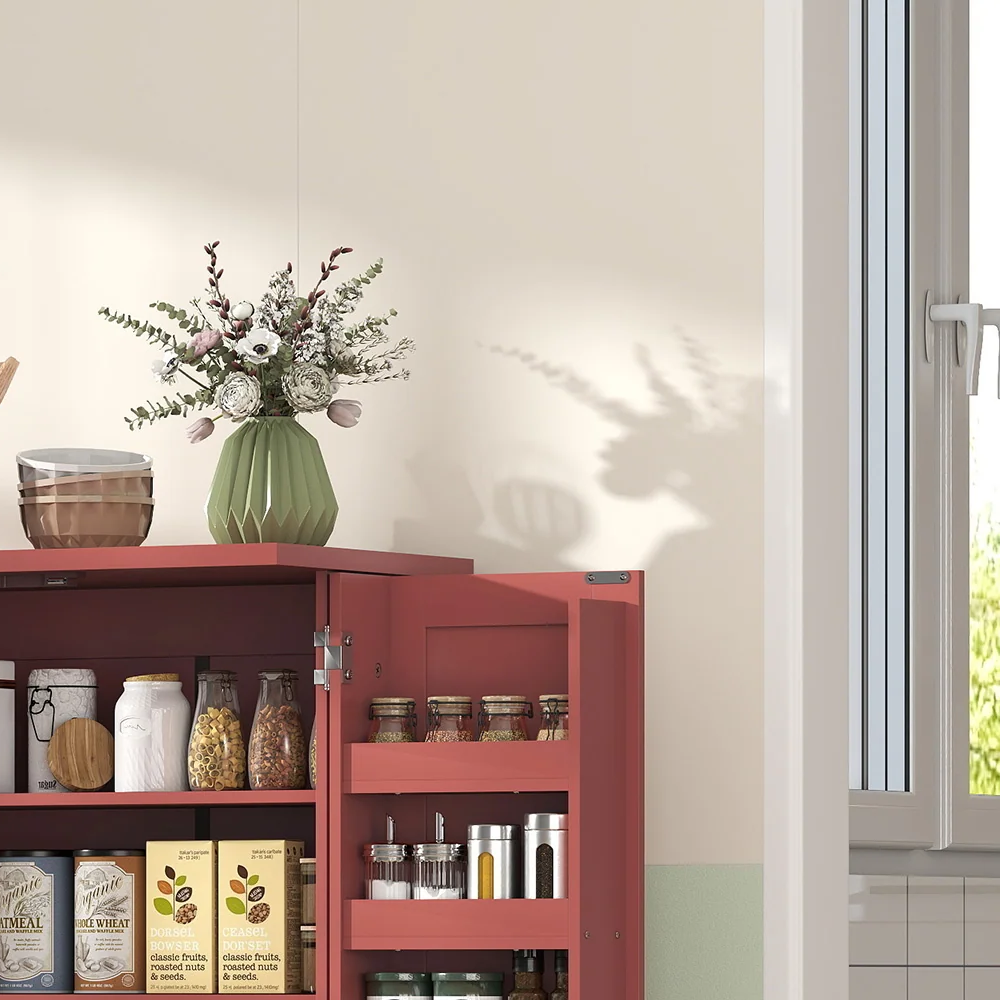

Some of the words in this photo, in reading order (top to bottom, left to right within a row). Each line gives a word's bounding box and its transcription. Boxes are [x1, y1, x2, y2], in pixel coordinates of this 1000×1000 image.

[96, 918, 130, 928] WHEAT
[150, 953, 180, 961] classic
[182, 953, 208, 962] fruits,
[222, 953, 253, 961] classic
[254, 953, 281, 962] fruits,
[150, 963, 183, 971] roasted
[185, 963, 206, 971] nuts
[222, 963, 256, 971] roasted
[258, 963, 279, 971] nuts
[150, 973, 159, 981] &
[160, 973, 187, 981] seeds.
[222, 973, 231, 981] &
[232, 973, 259, 981] seeds.
